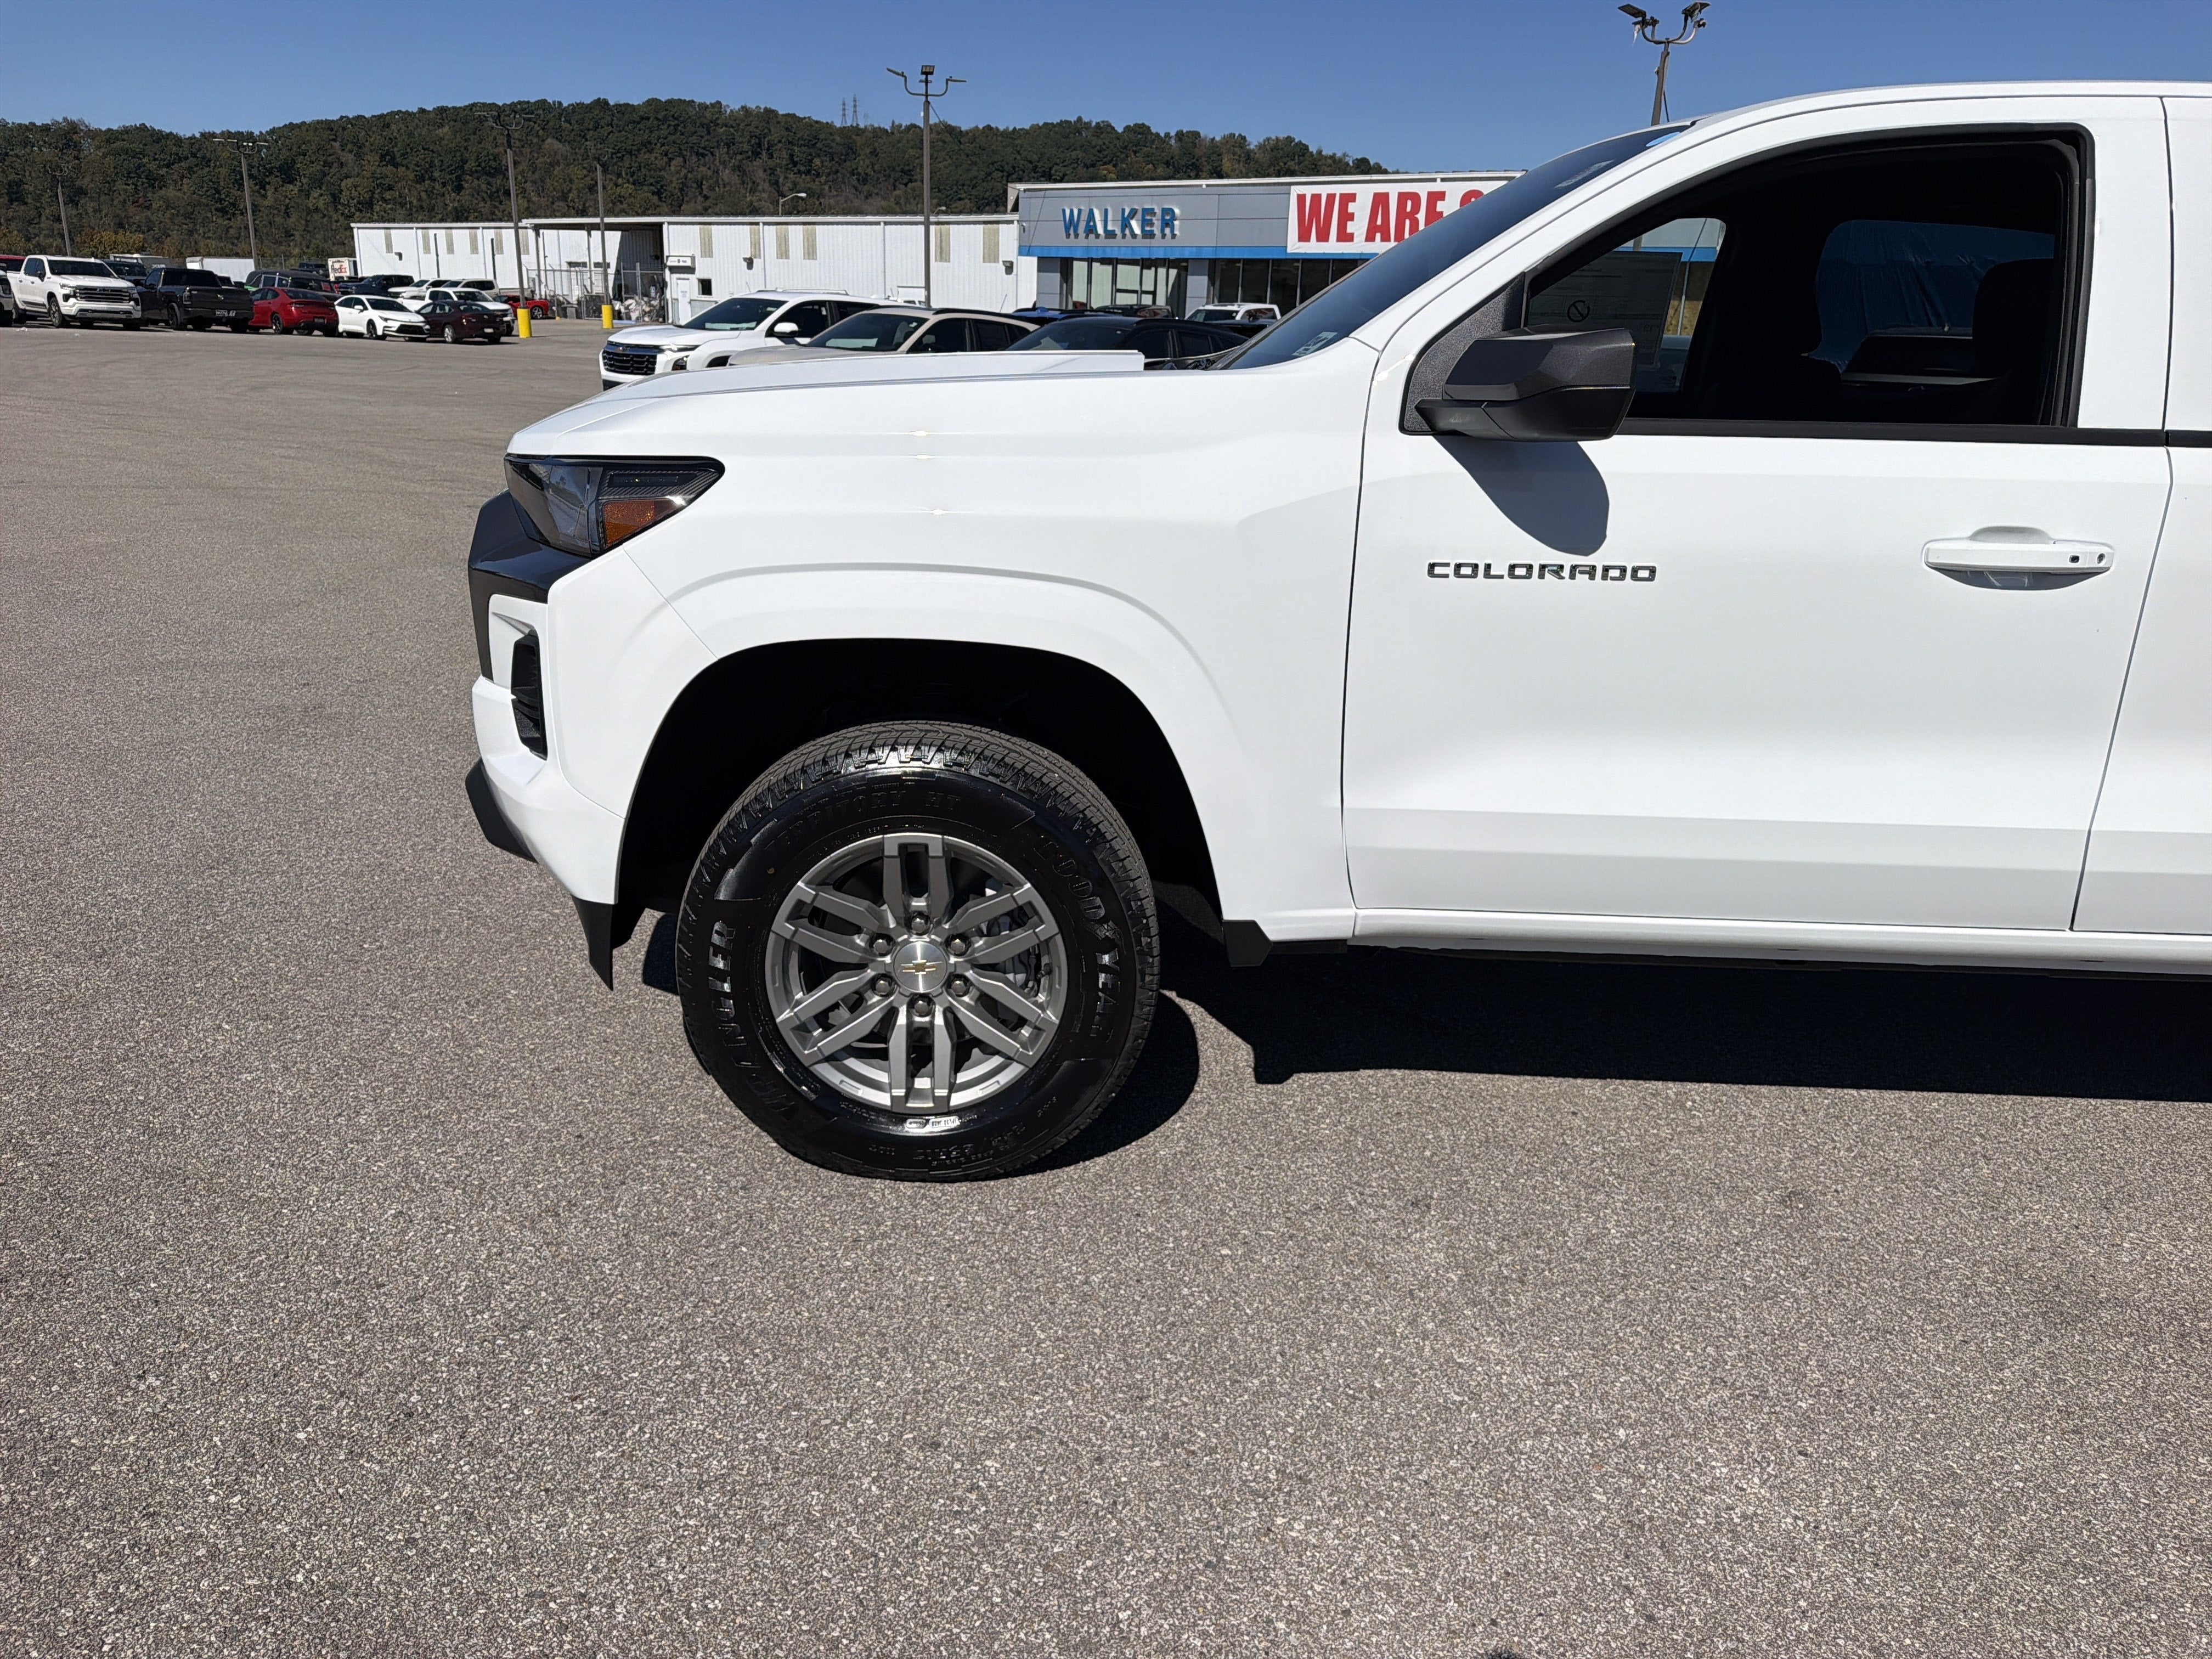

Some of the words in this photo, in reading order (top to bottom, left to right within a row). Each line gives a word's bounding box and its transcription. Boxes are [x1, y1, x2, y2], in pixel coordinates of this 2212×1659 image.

[1062, 207, 1177, 236] WALKER
[1296, 193, 1357, 242] WE
[1427, 561, 1657, 582] COLORADO
